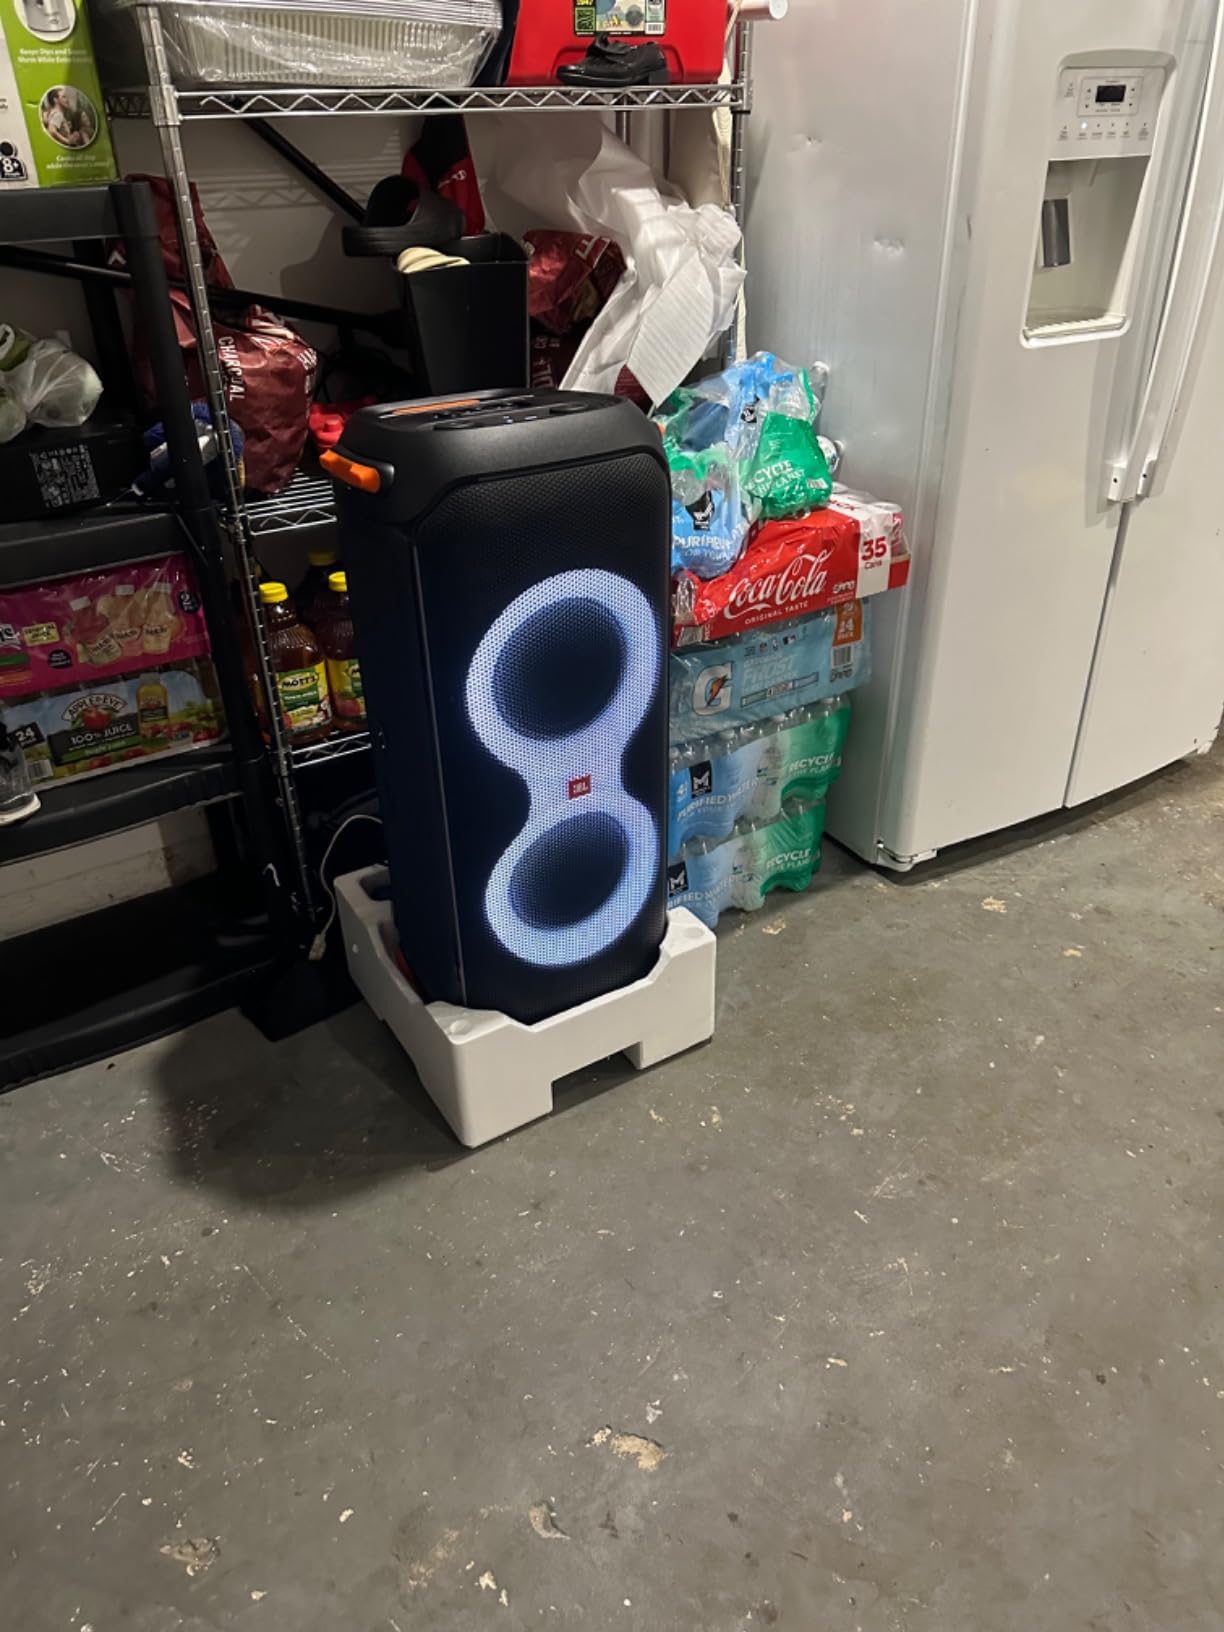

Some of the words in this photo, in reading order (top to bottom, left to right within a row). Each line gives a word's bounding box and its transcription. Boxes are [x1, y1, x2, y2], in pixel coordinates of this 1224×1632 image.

[2, 158, 19, 173] 8+
[861, 535, 887, 561] 35
[723, 549, 833, 618] Coca-Cola
[744, 610, 783, 624] ORIGINAL
[784, 601, 809, 613] TASTE
[693, 661, 733, 716] G
[15, 727, 35, 743] 24
[667, 891, 704, 909] RIFIED
